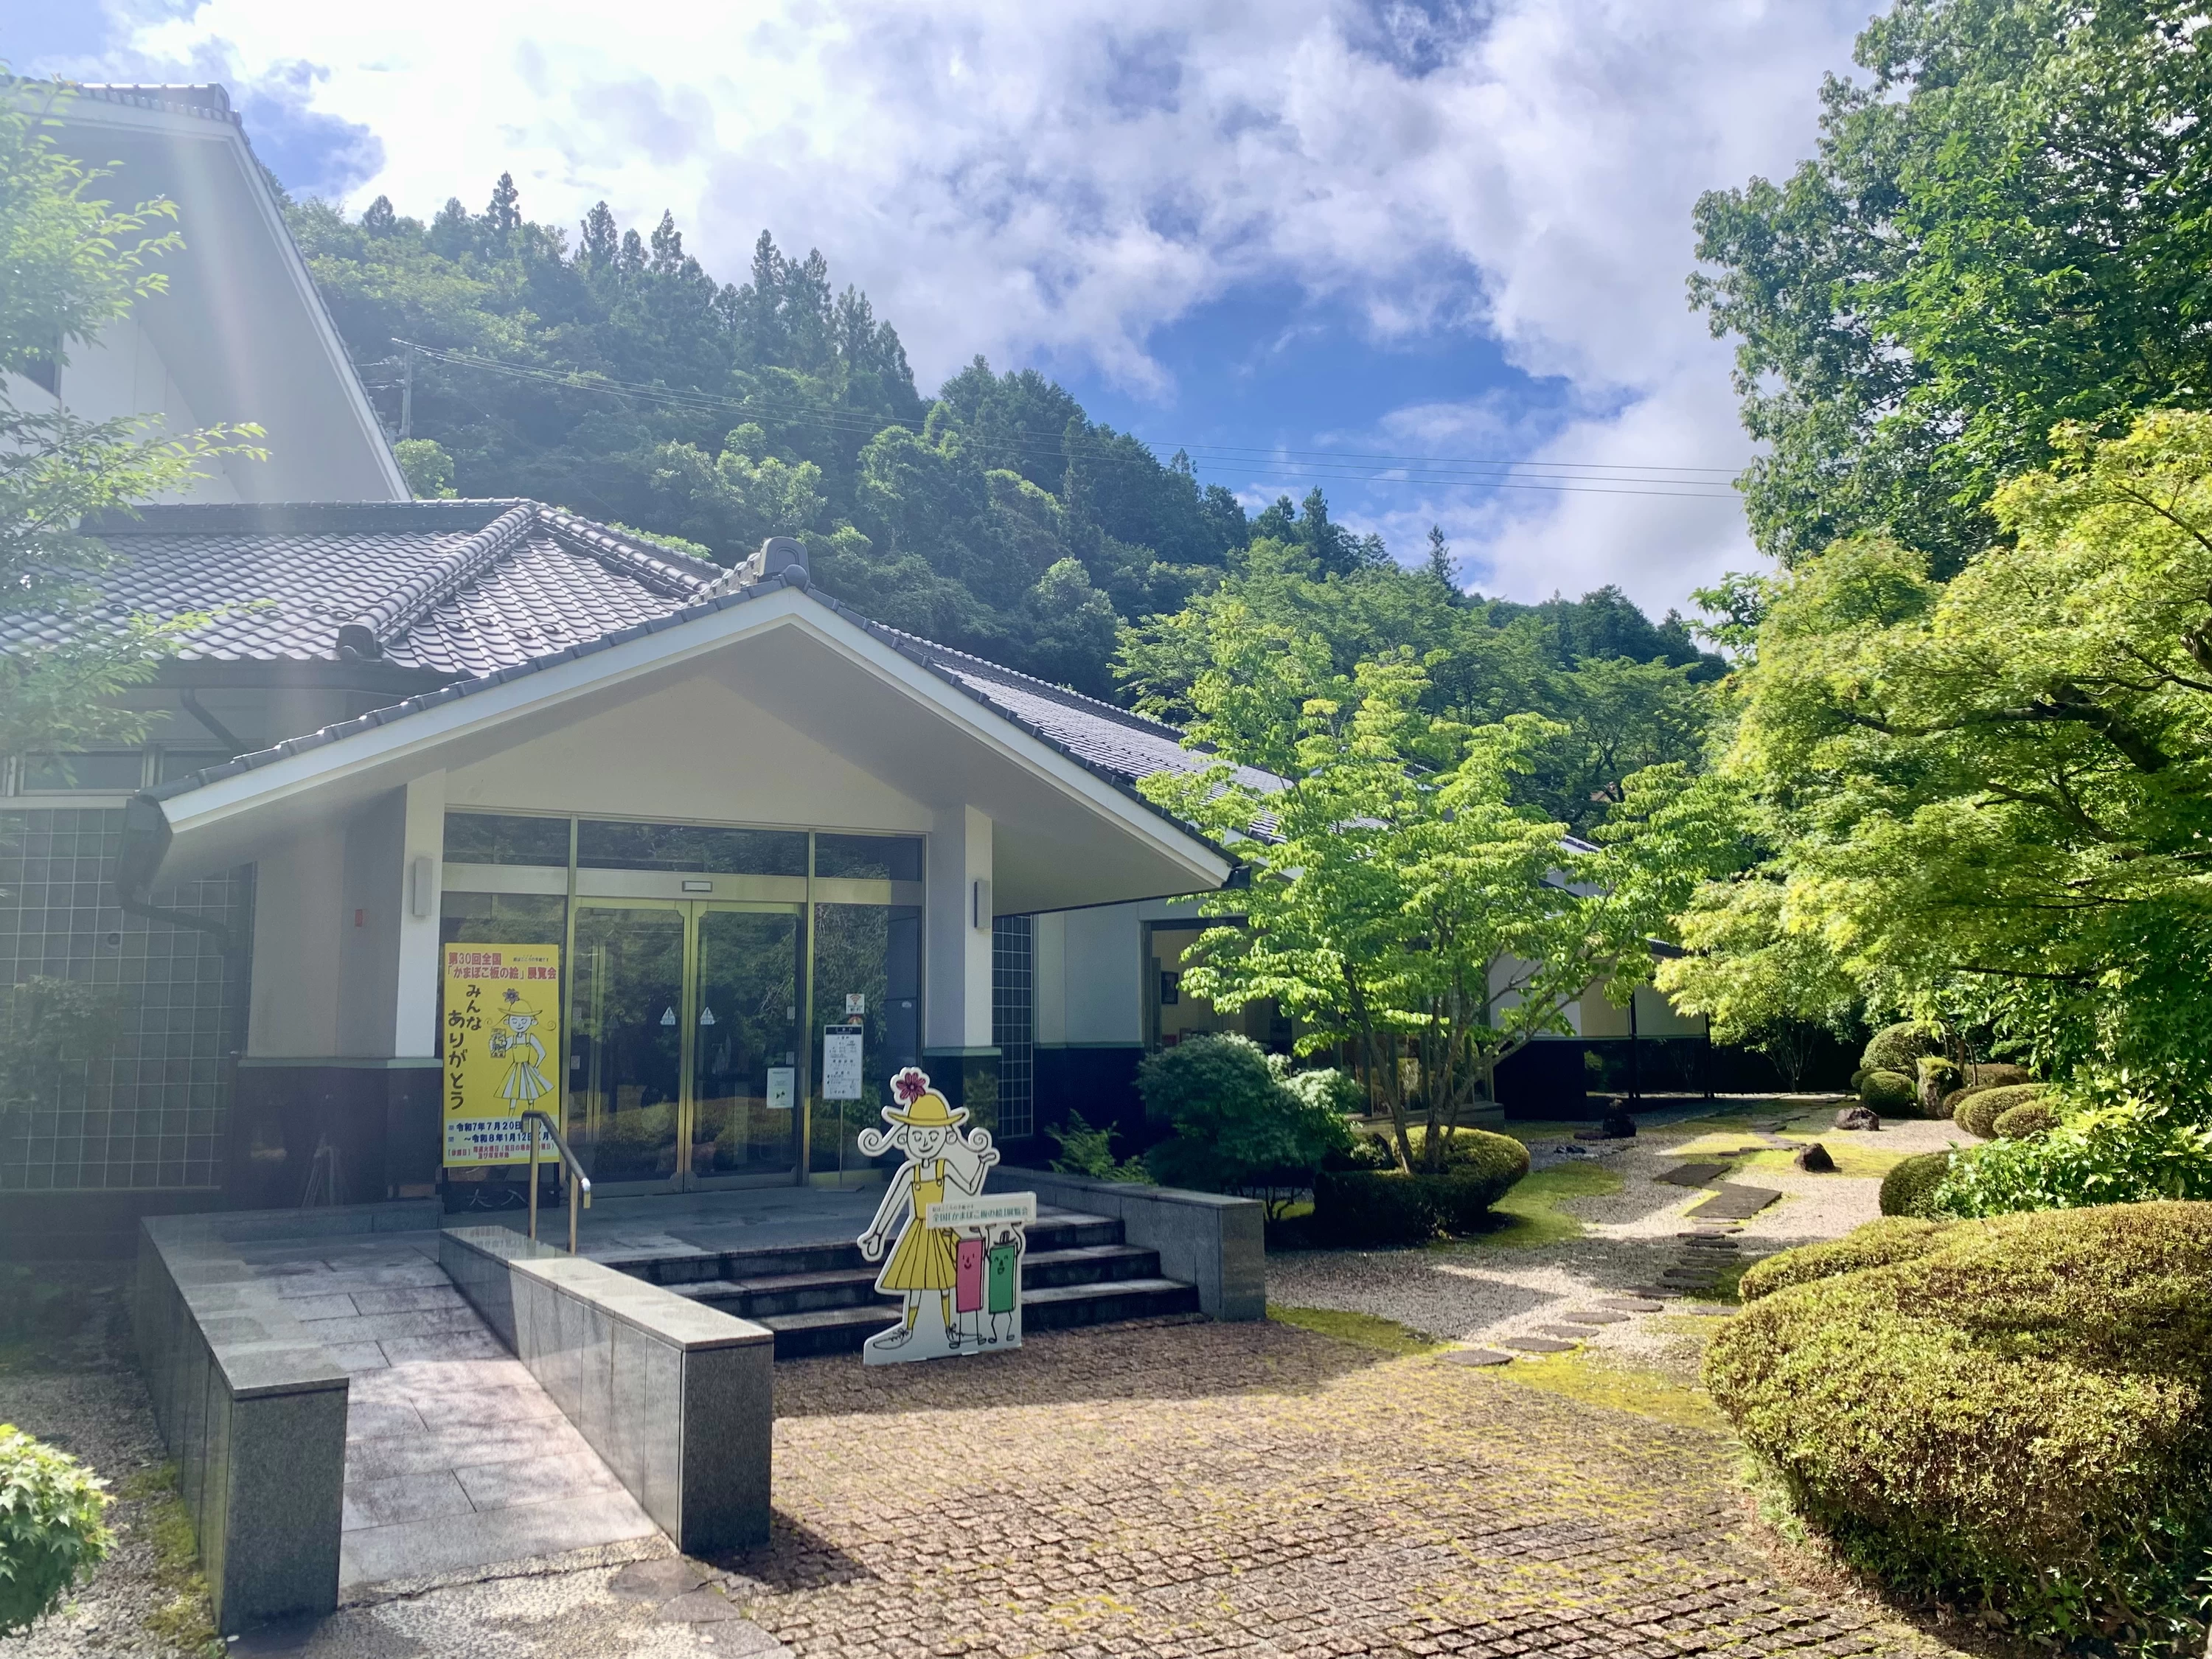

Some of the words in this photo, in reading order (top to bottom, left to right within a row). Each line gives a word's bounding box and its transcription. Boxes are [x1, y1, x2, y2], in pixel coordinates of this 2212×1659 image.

[448, 952, 501, 965] 第30回全国
[448, 965, 557, 979] 「かまぼこ板の絵」展覧会
[466, 984, 481, 1031] みんな
[448, 1009, 467, 1110] ありがとう
